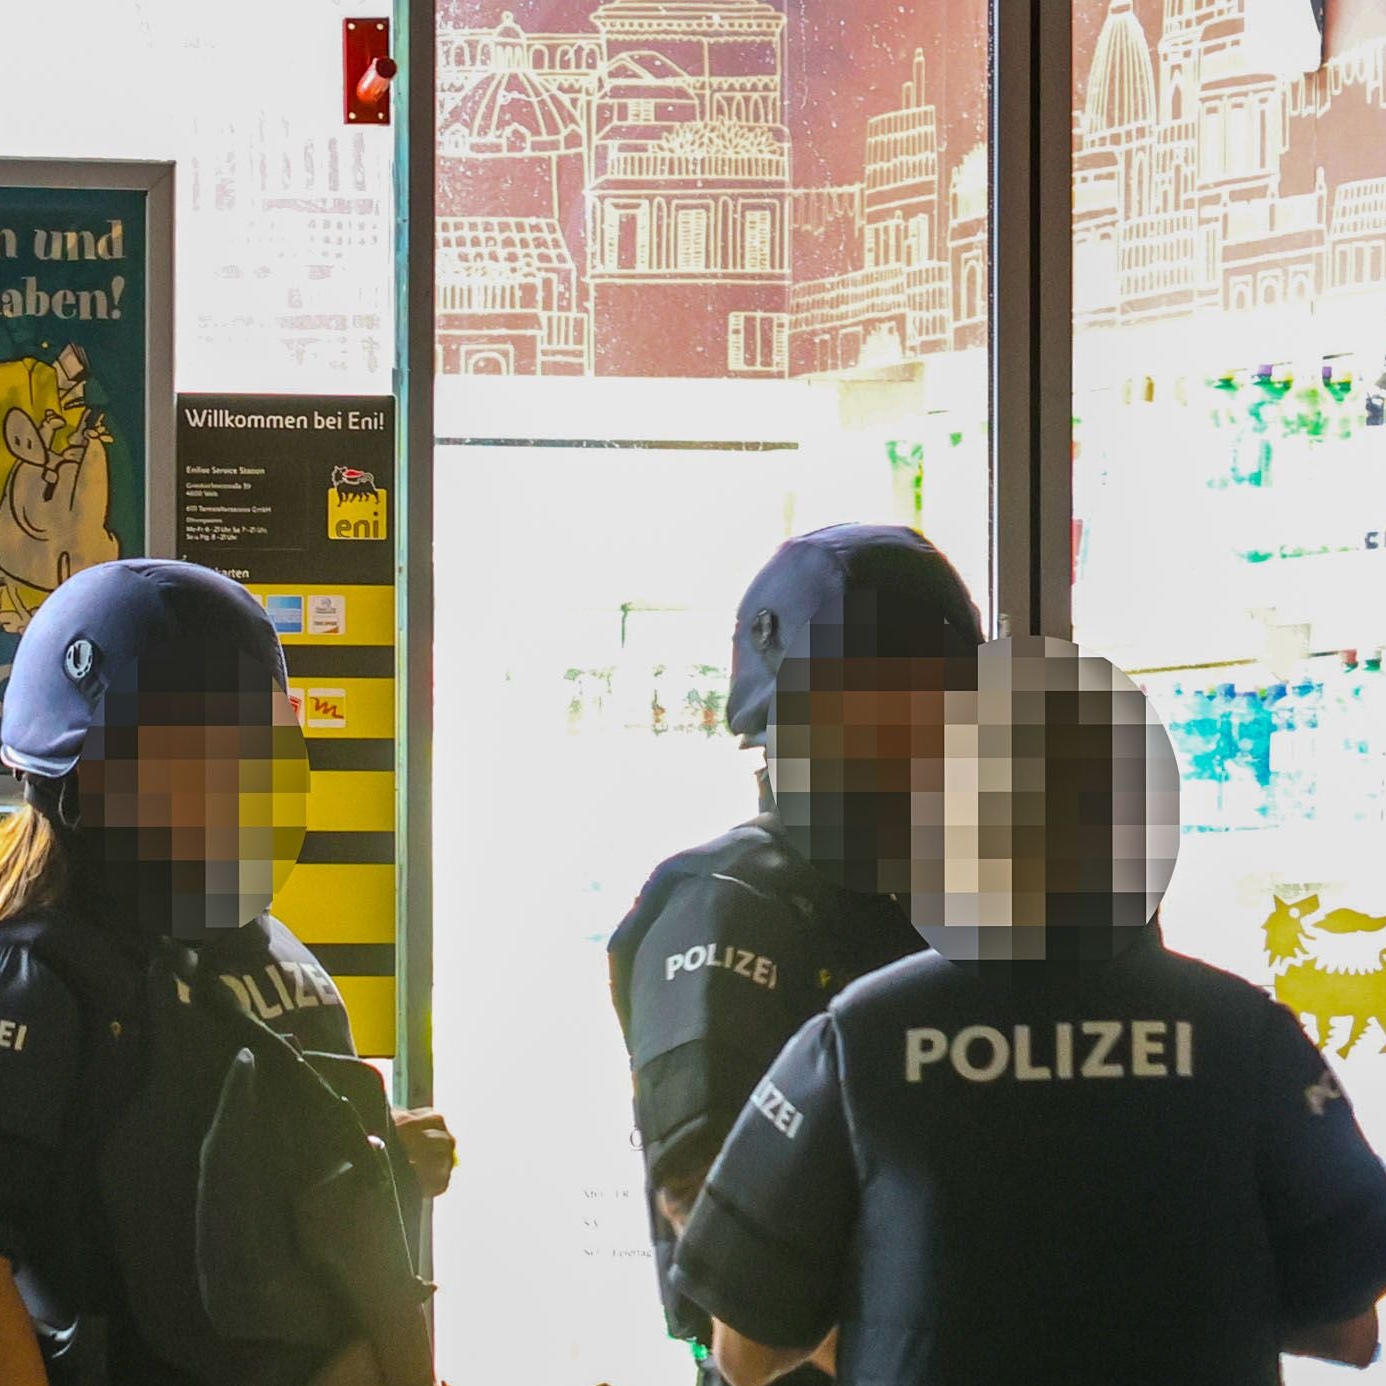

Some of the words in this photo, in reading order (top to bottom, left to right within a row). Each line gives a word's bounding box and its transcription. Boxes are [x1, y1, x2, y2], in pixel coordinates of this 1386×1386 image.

[34, 220, 126, 261] und
[185, 409, 308, 429] Willkommen
[314, 411, 342, 429] bei
[348, 412, 385, 430] Eni!
[335, 511, 380, 539] eni
[666, 943, 778, 990] POLIZEI
[905, 1021, 1194, 1082] POLIZEI
